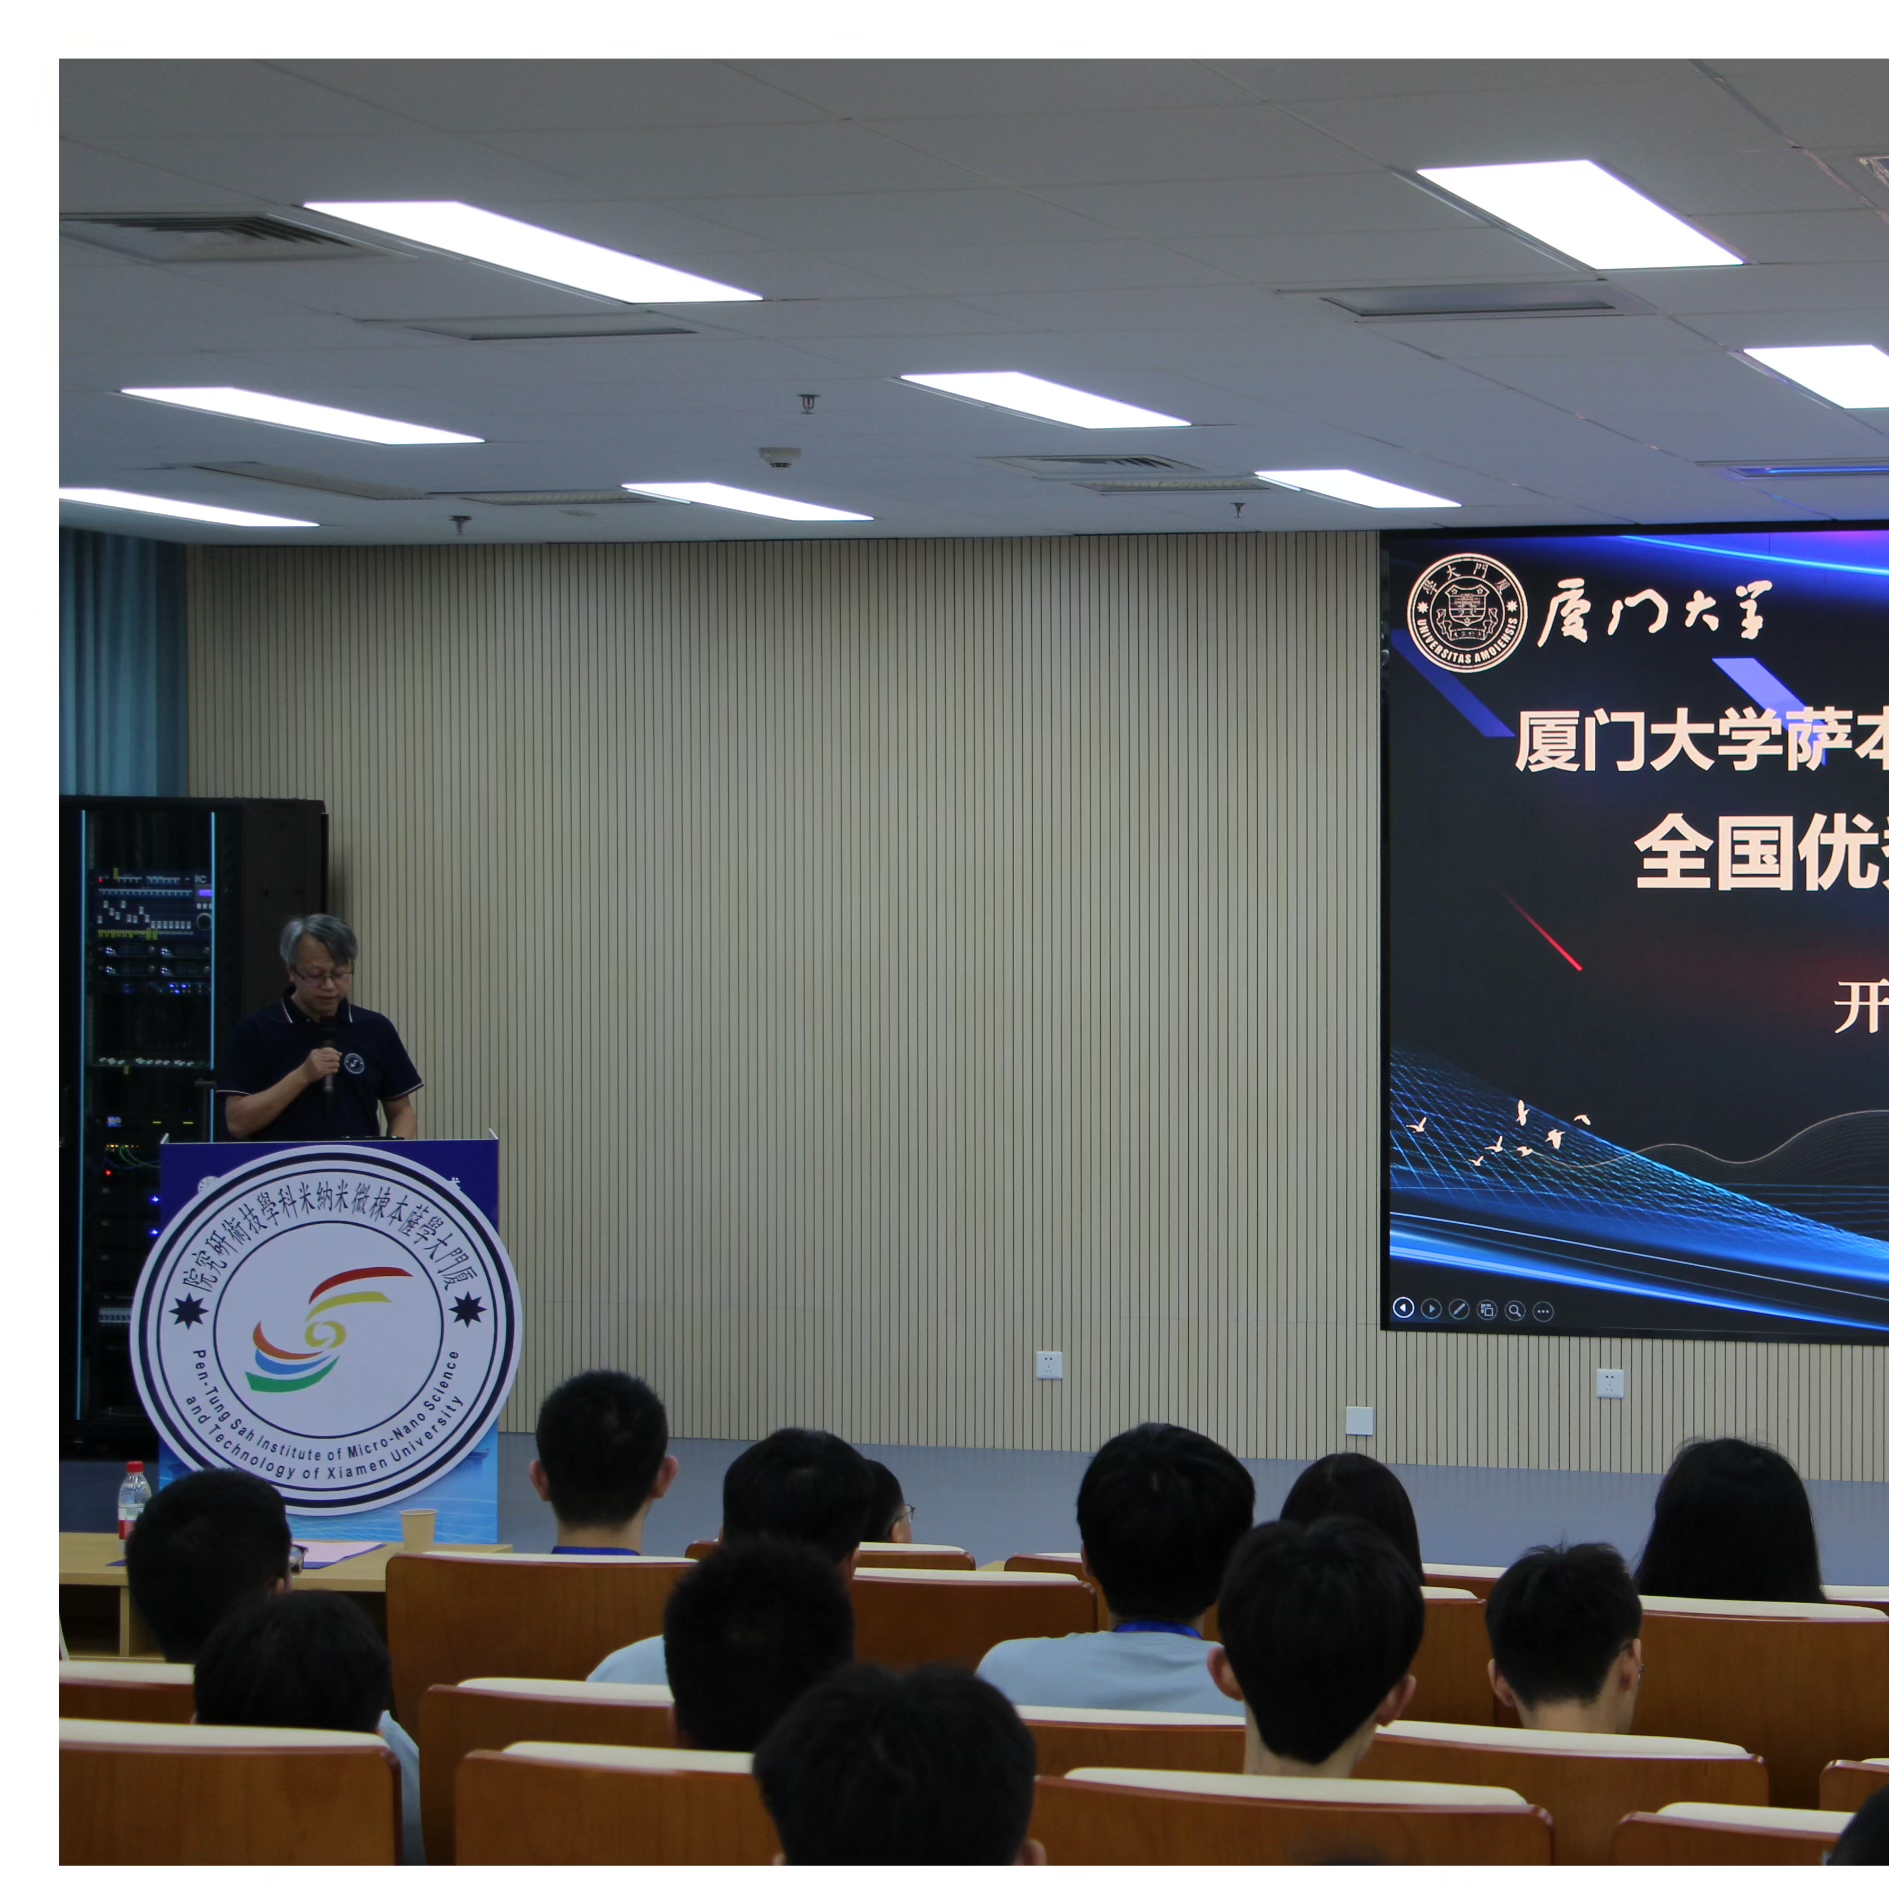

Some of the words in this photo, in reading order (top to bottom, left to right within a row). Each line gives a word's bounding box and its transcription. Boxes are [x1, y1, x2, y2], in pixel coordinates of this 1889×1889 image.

[1416, 617, 1472, 665] UNIVERSITAS
[1473, 616, 1518, 664] AMOIENSIS
[186, 1396, 211, 1425] and
[208, 1423, 296, 1480] Technology
[302, 1467, 320, 1480] of
[327, 1458, 388, 1480] Xiamen
[390, 1396, 464, 1462] University
[193, 1349, 231, 1422] Pen-Tung
[230, 1418, 255, 1442] Sah
[256, 1435, 321, 1461] Institute
[327, 1447, 342, 1461] of
[347, 1412, 426, 1459] Micro-Nano
[423, 1351, 459, 1411] Science
